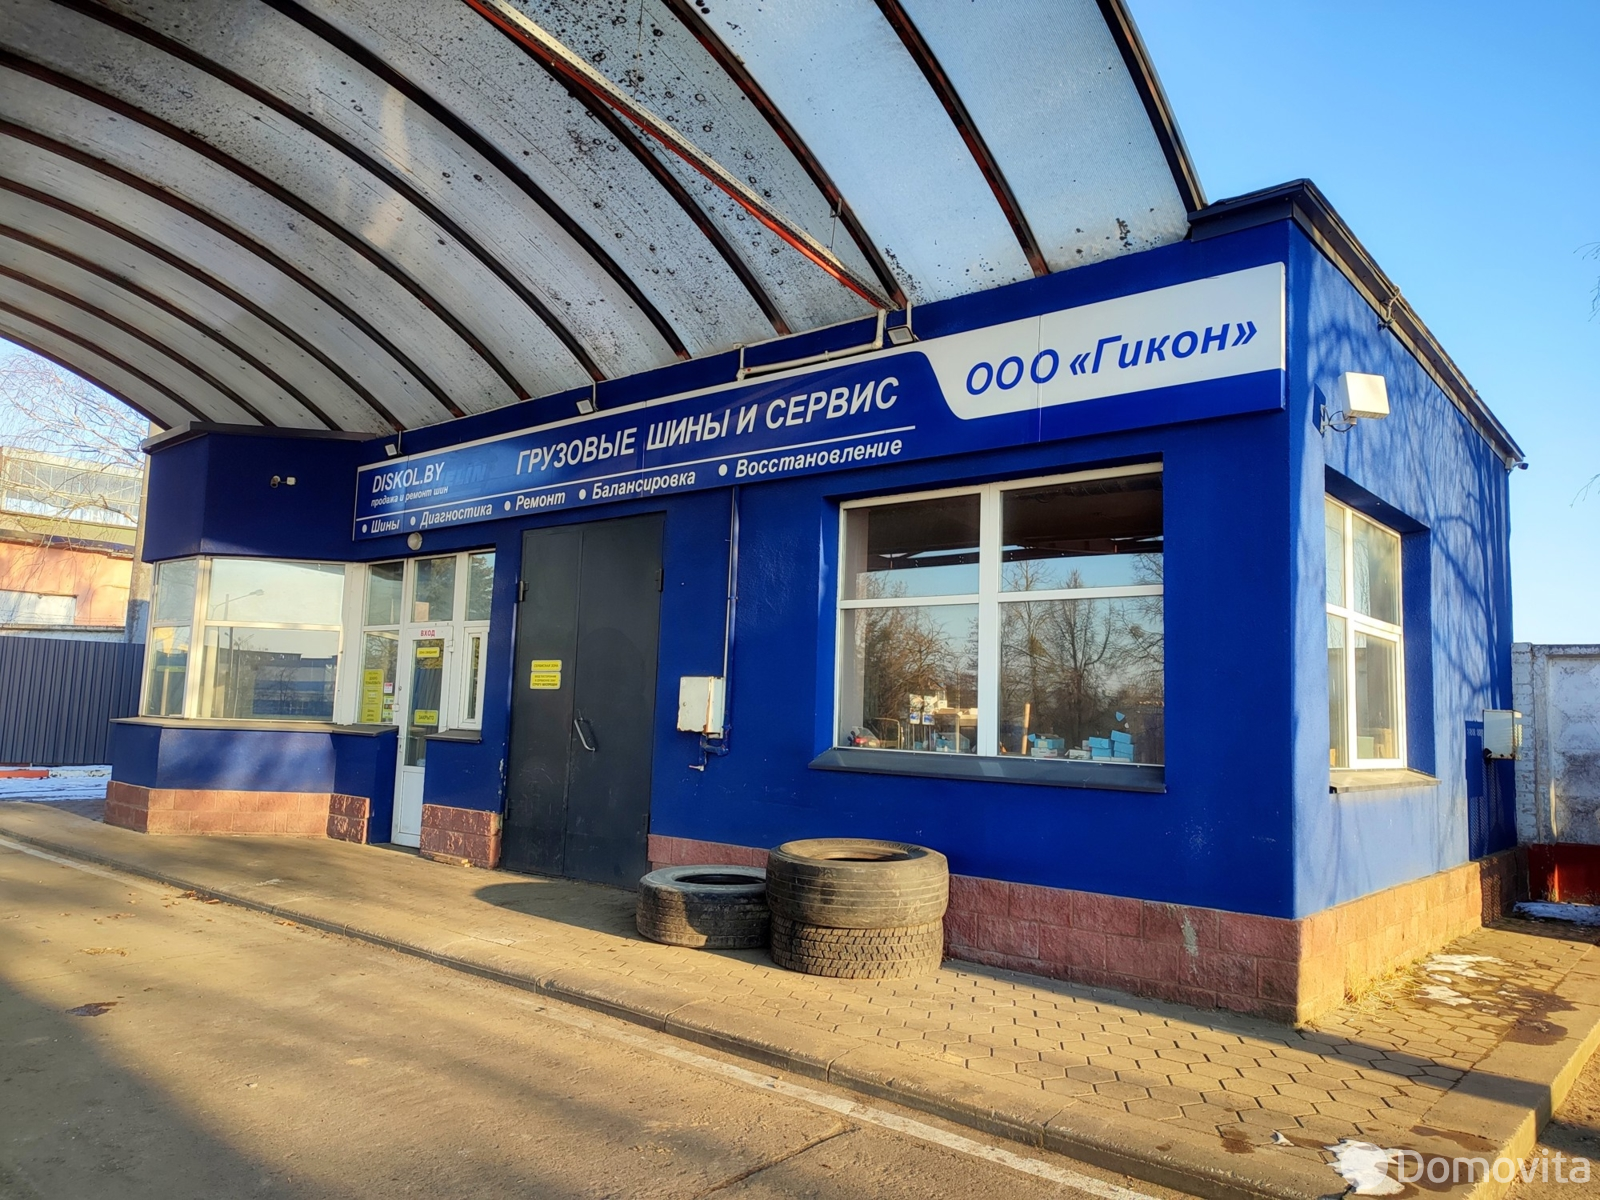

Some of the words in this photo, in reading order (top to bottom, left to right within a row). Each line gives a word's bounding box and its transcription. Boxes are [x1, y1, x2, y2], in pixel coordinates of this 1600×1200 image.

[965, 349, 1060, 396] ООО
[1069, 320, 1258, 376] «Гикон»
[516, 427, 637, 475] ГРУЗОВЫЕ
[646, 411, 731, 452] ШИНЫ
[736, 403, 759, 435] И
[765, 376, 900, 431] СЕРВИС
[371, 519, 400, 534] Шины
[419, 503, 493, 529] Диагностика
[515, 491, 566, 511] Ремонт
[592, 469, 696, 501] Балансировка
[735, 439, 903, 478] Восстановление
[371, 495, 398, 509] продажа
[399, 494, 405, 502] и
[405, 489, 432, 503] ремонт
[433, 486, 449, 497] шин
[372, 461, 446, 494] DISKOL.BY
[420, 629, 436, 637] ВХОД
